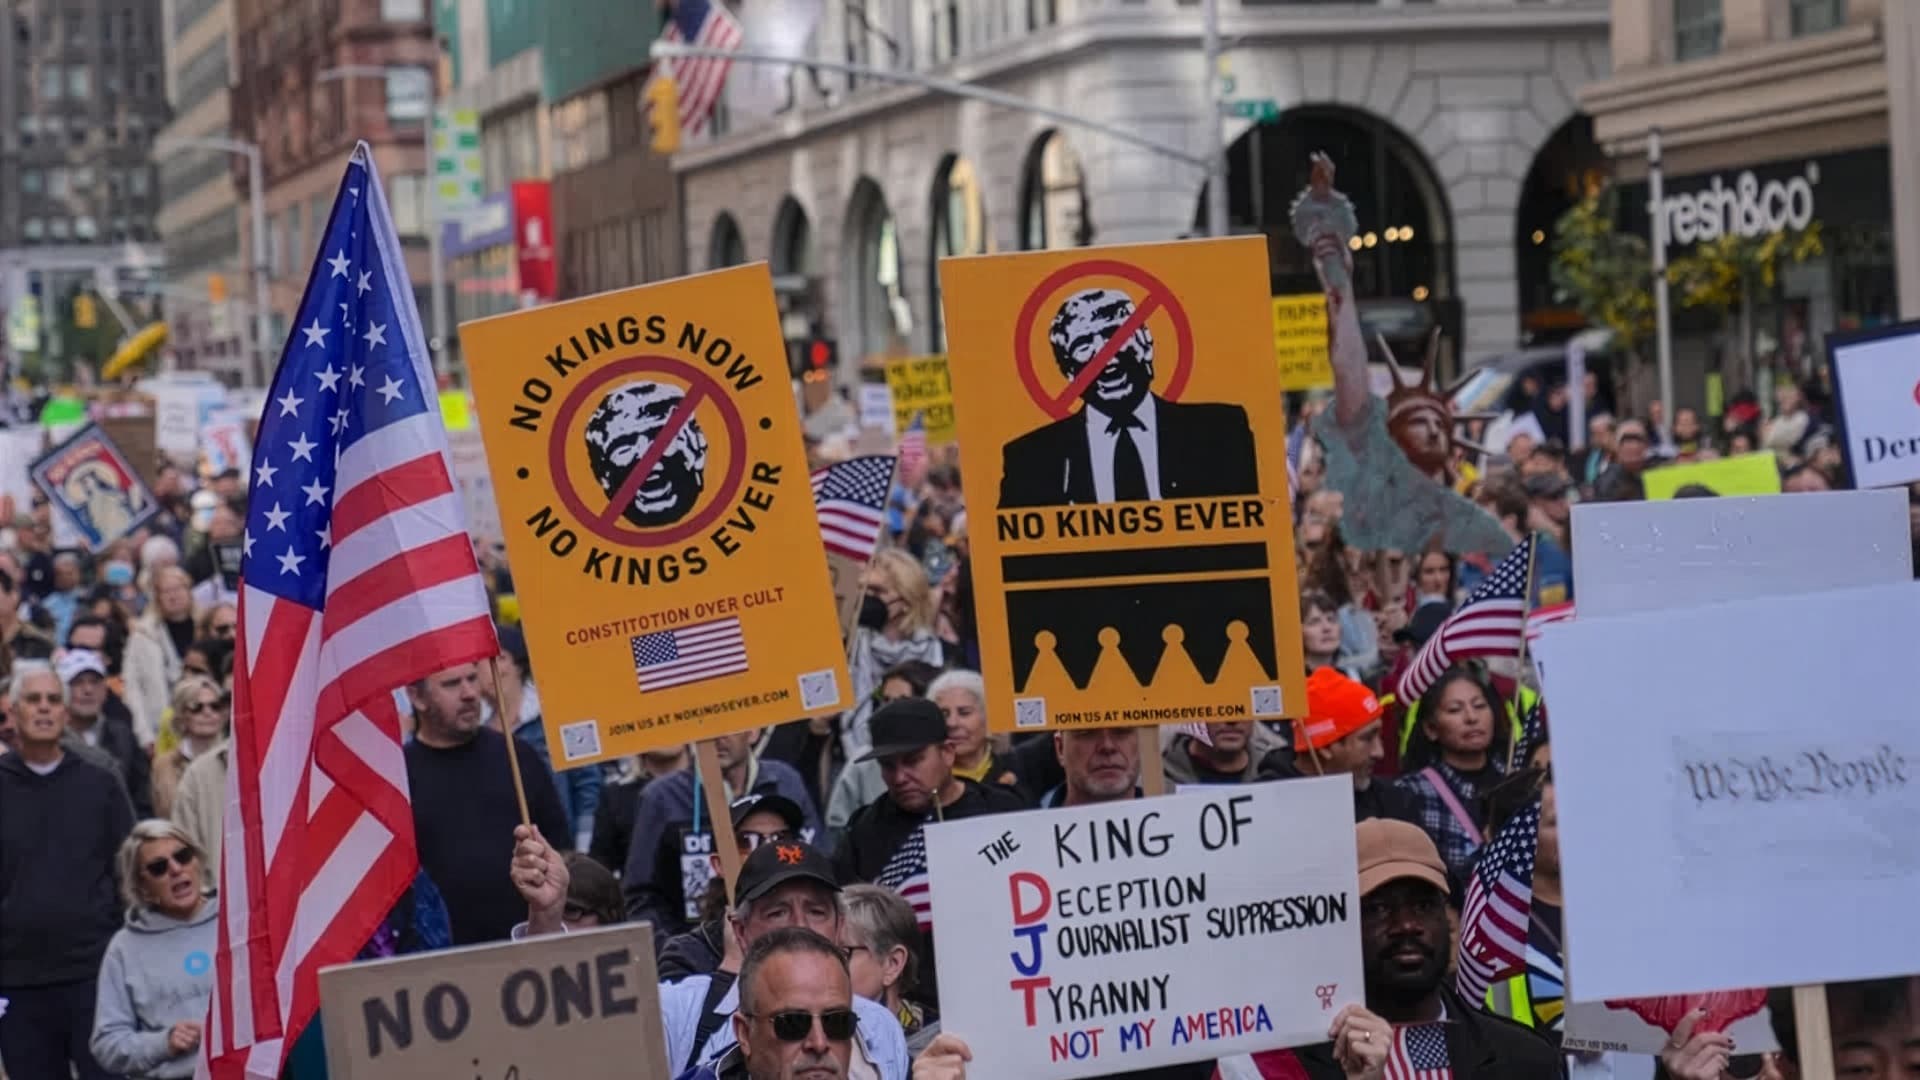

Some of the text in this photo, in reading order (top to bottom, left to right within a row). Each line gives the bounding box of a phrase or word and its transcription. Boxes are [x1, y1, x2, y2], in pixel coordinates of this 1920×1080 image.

[510, 315, 763, 432] NO KINGS NOW
[526, 461, 782, 585] NO KINGS EVER
[997, 499, 1266, 542] NO KINGS EVER
[694, 596, 739, 619] OVER
[743, 586, 785, 609] CULT
[609, 721, 636, 737] JOIN
[638, 717, 655, 730] US
[656, 713, 672, 726] AT
[1055, 711, 1082, 725] JOIN
[1085, 710, 1102, 723] US
[1103, 710, 1119, 722] AT
[1684, 758, 1740, 804] We
[1797, 744, 1907, 795] People
[977, 794, 1254, 869] THE KING OF
[1008, 871, 1207, 926] DECEPTION
[1010, 891, 1348, 977] JOURNALIST SUPPRESSION
[361, 947, 639, 1059] NO ONE
[1010, 973, 1171, 1027] TYRANNY
[1050, 1003, 1274, 1063] NOT MY AMERICA
